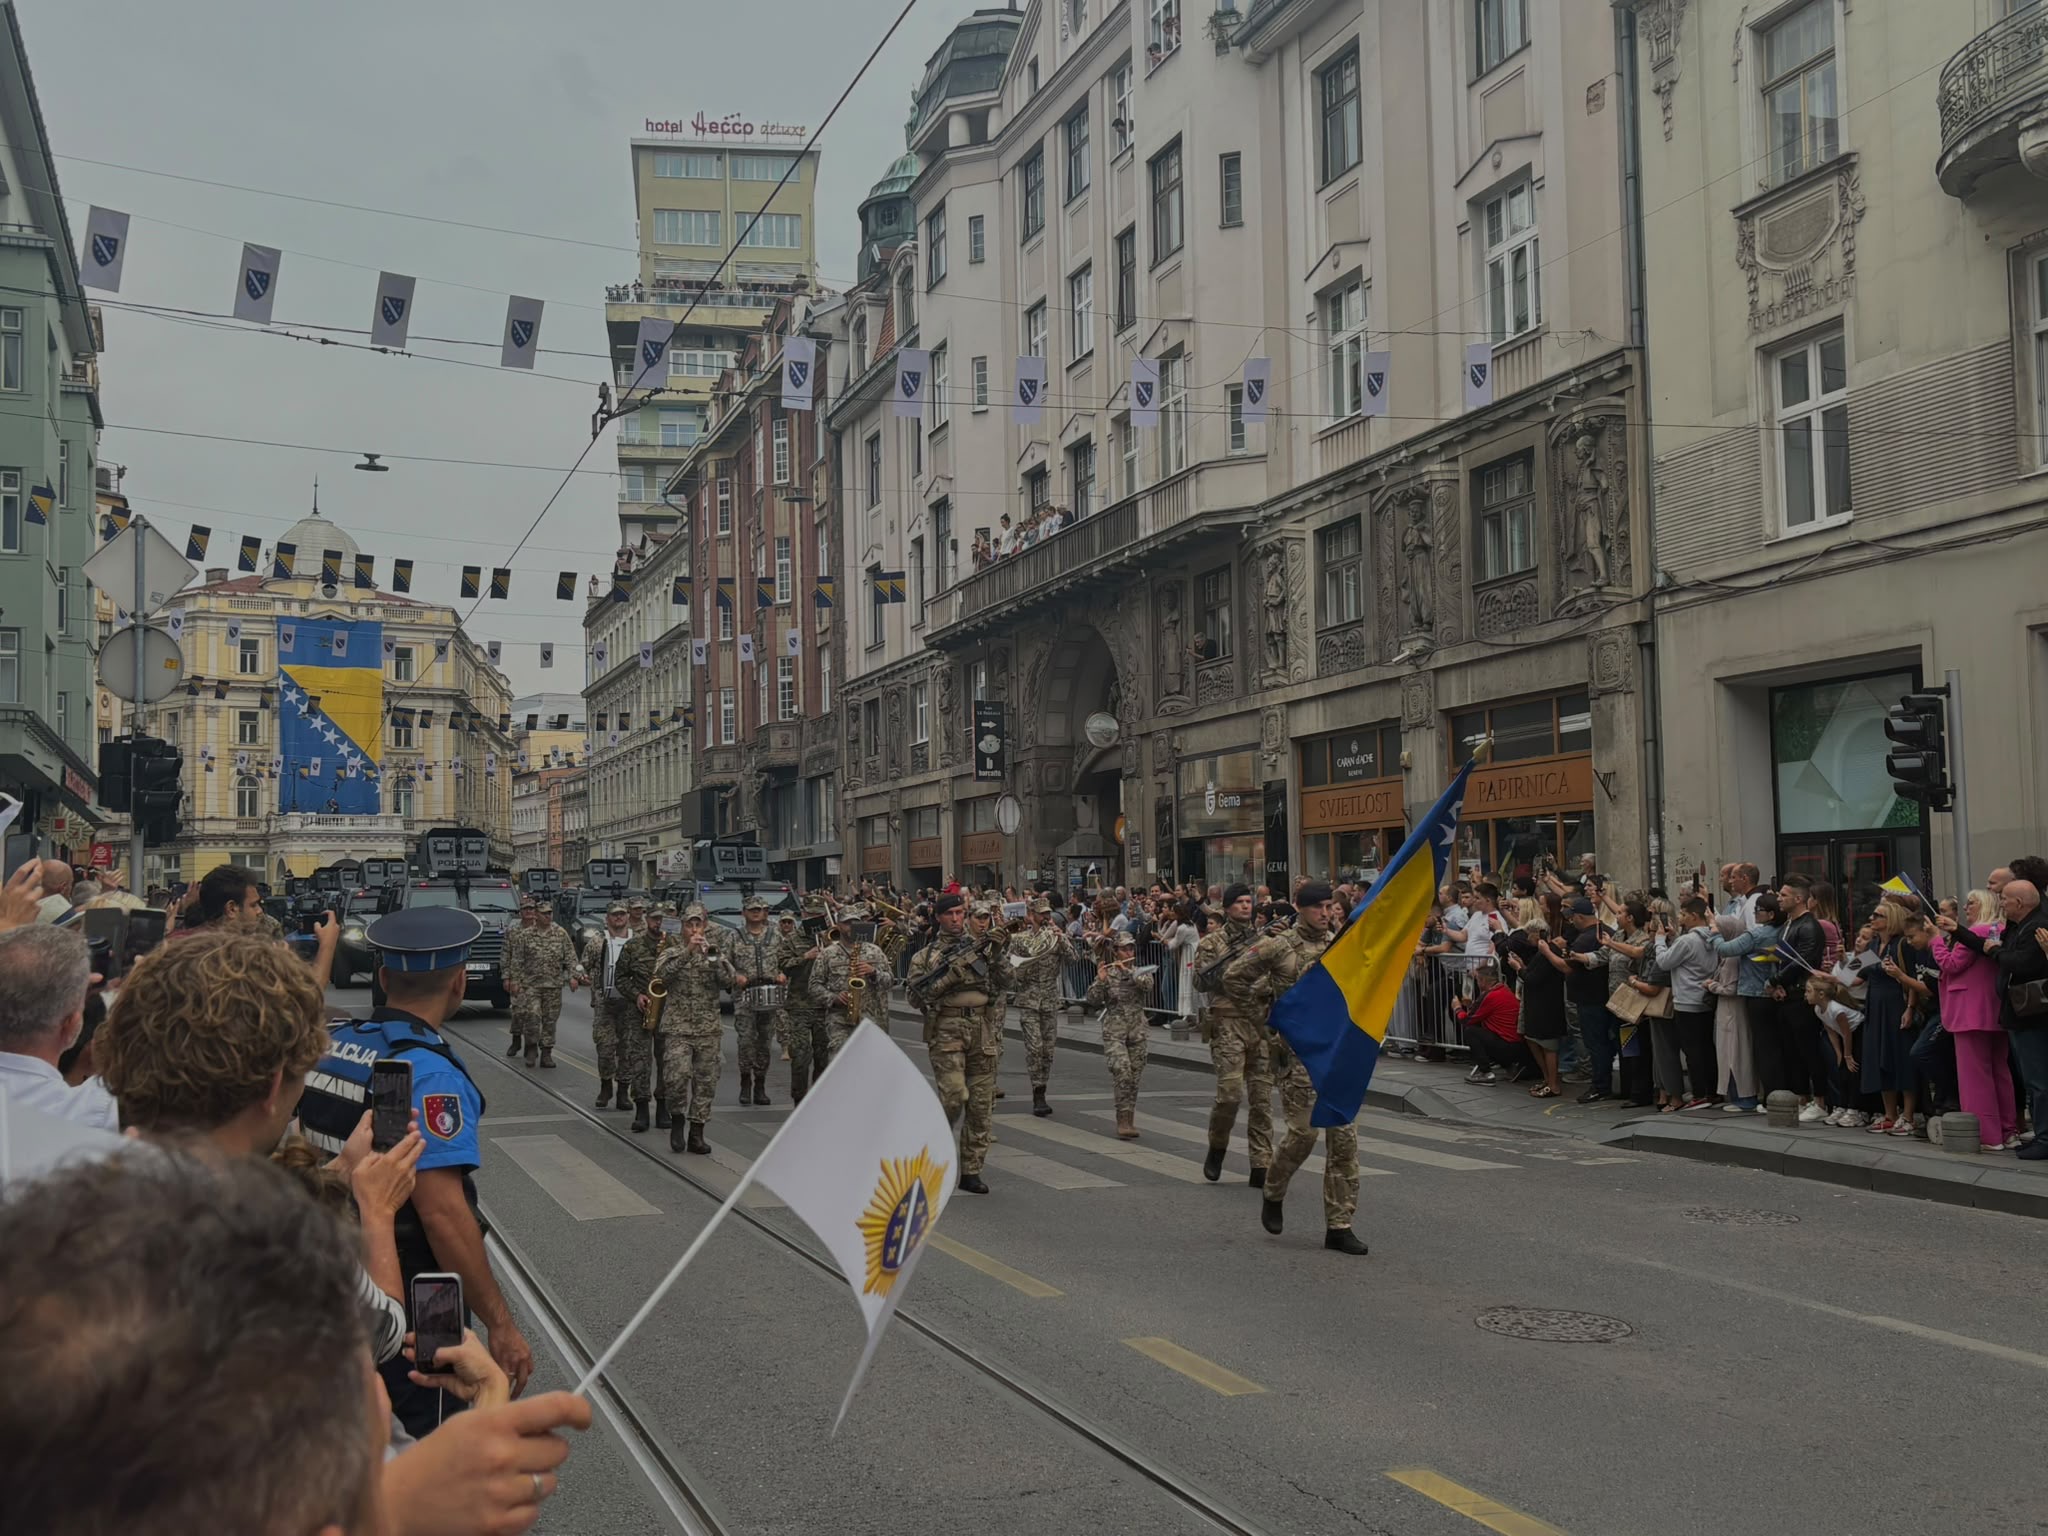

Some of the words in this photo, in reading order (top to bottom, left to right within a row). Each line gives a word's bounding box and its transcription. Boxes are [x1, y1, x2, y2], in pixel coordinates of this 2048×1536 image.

[645, 118, 683, 133] hotel
[691, 110, 755, 136] Hecco
[760, 121, 807, 137] deluxe
[1336, 756, 1355, 768] CARAN
[1477, 771, 1569, 802] PAPIRNICA
[1218, 793, 1241, 808] Gema
[1319, 791, 1392, 819] SVJETLOST
[437, 858, 482, 867] POLICIJA
[722, 866, 762, 874] POLICIJA
